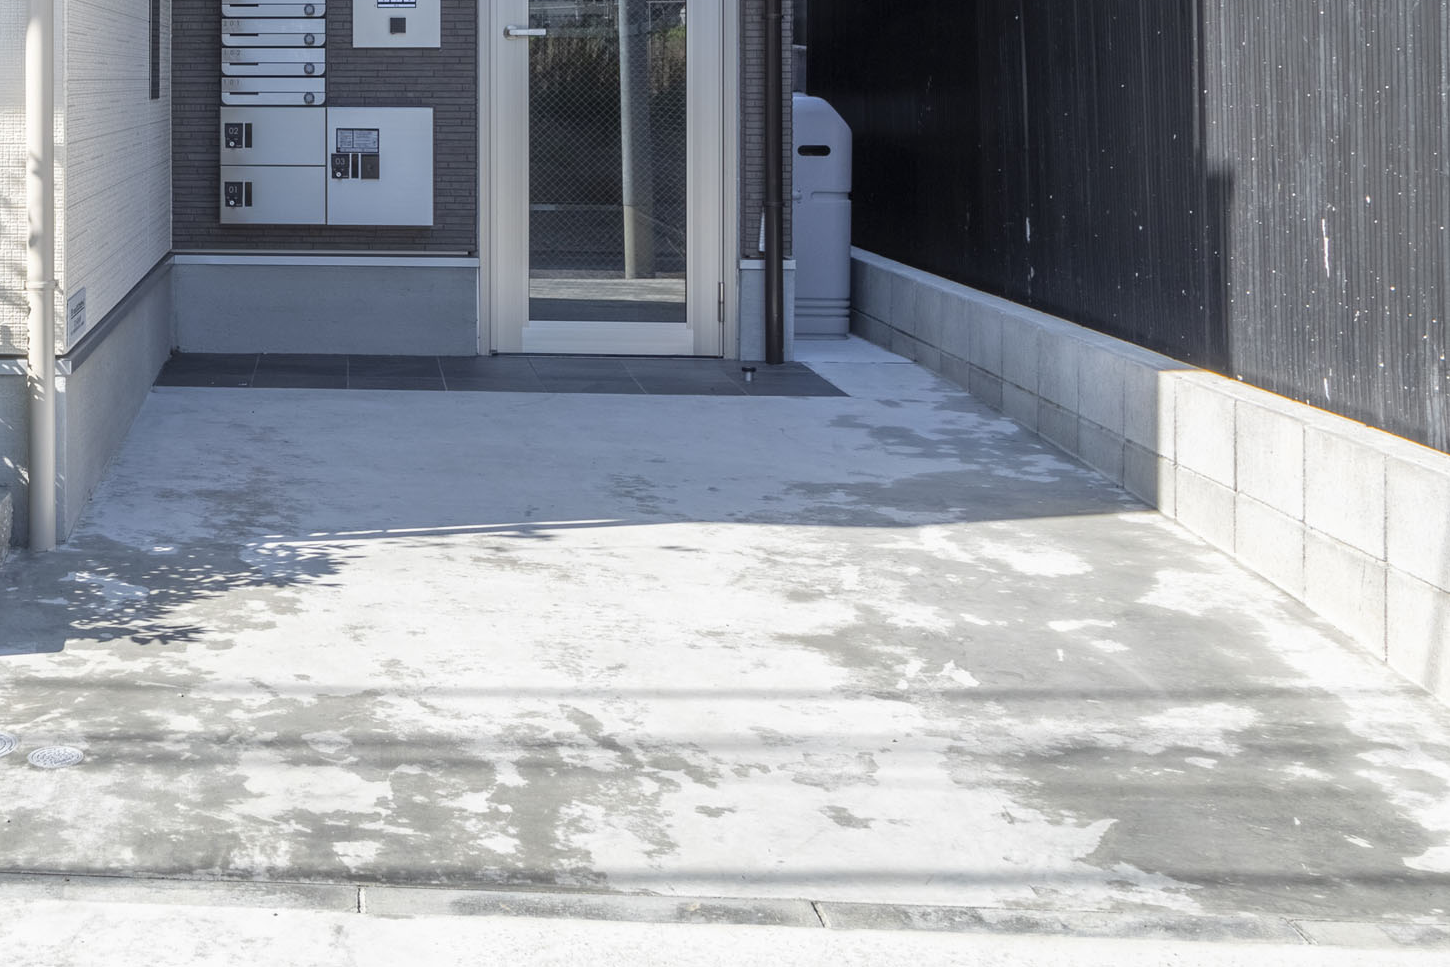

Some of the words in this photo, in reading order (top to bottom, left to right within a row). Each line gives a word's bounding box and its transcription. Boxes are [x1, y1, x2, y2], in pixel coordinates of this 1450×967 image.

[228, 127, 239, 135] 02
[335, 158, 346, 166] 03
[228, 185, 238, 194] 01
